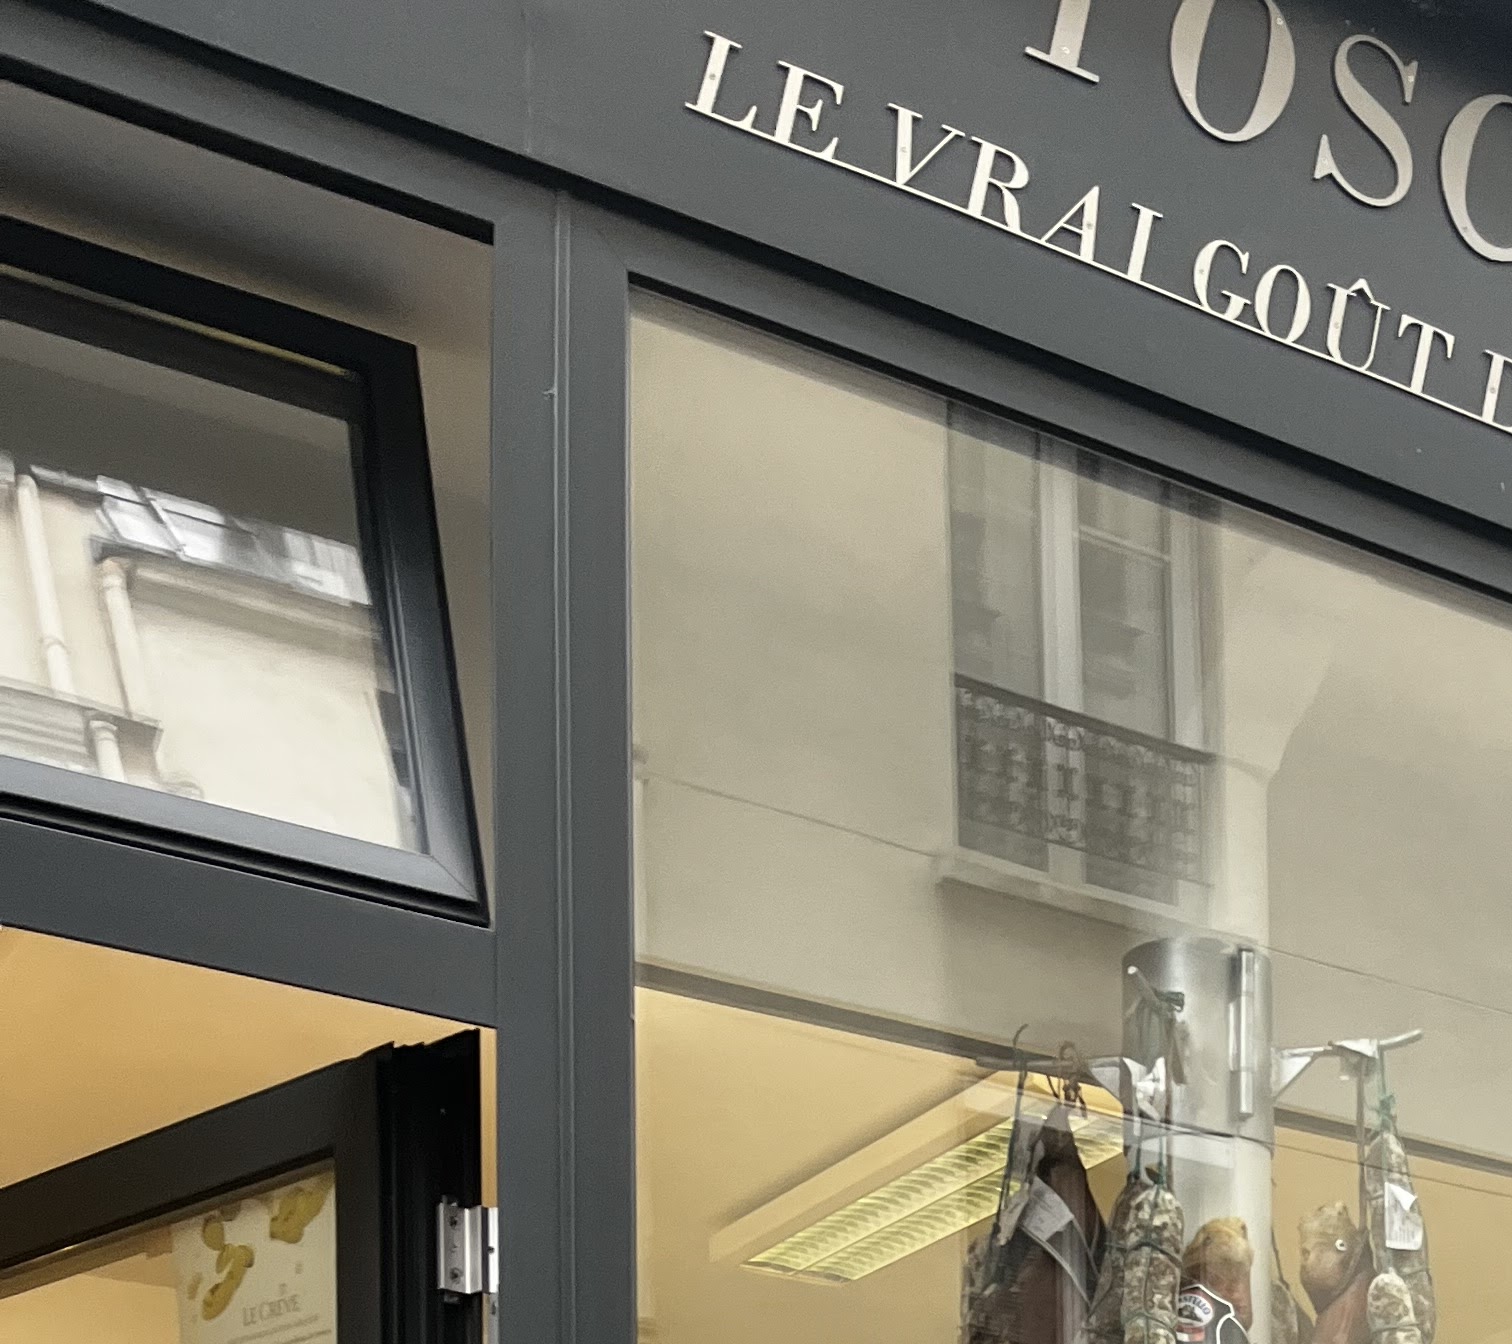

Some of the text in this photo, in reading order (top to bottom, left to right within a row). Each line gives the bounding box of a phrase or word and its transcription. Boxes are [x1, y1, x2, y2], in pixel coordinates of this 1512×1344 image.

[685, 30, 845, 162] LE
[887, 103, 1163, 285] VRAI
[1193, 239, 1455, 395] GOÛT
